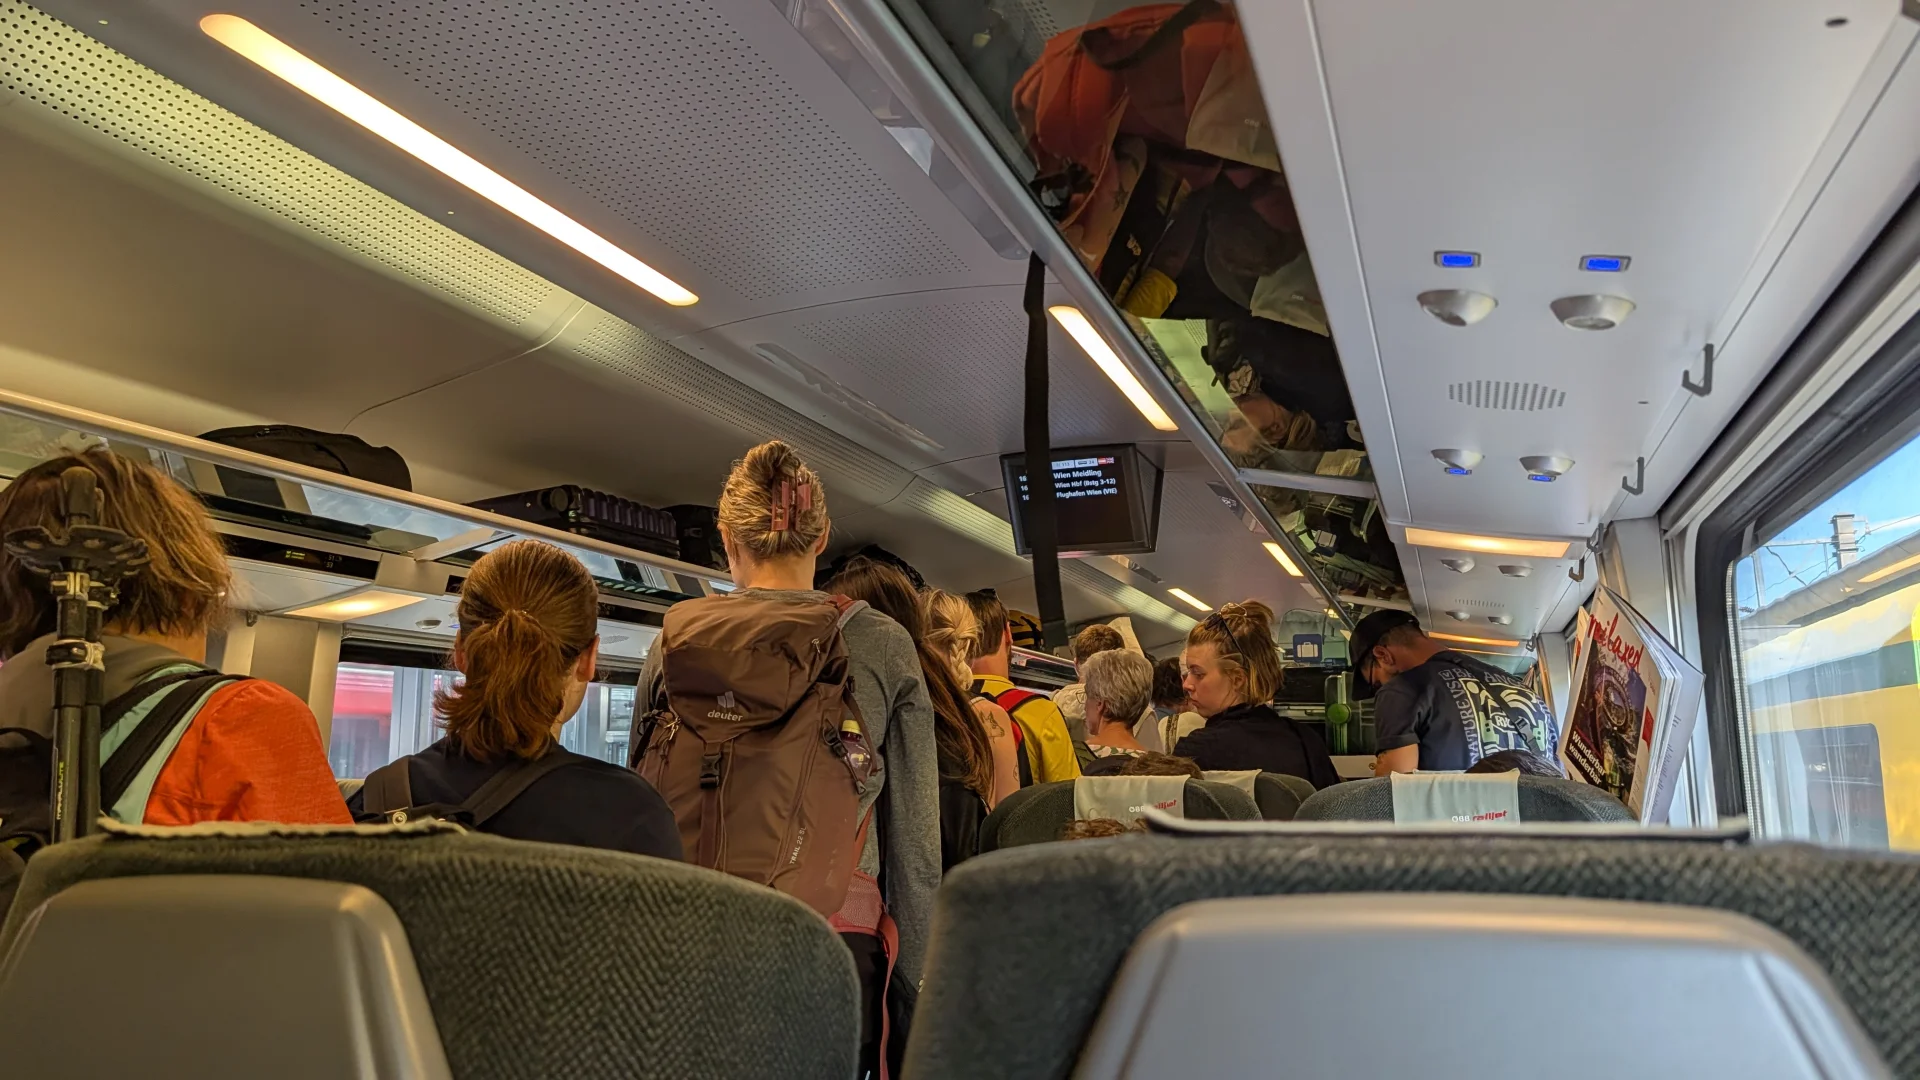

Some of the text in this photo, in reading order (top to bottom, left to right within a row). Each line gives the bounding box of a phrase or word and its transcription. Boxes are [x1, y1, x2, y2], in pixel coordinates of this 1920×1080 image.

[1056, 490, 1086, 498] Flughafen
[707, 709, 743, 721] deuter
[1456, 699, 1480, 766] NATURE
[1569, 743, 1602, 784] wanderbar
[1572, 730, 1606, 776] Wunderbar
[1472, 810, 1507, 821] railjet
[789, 826, 807, 864] TRAIL 22 SL
